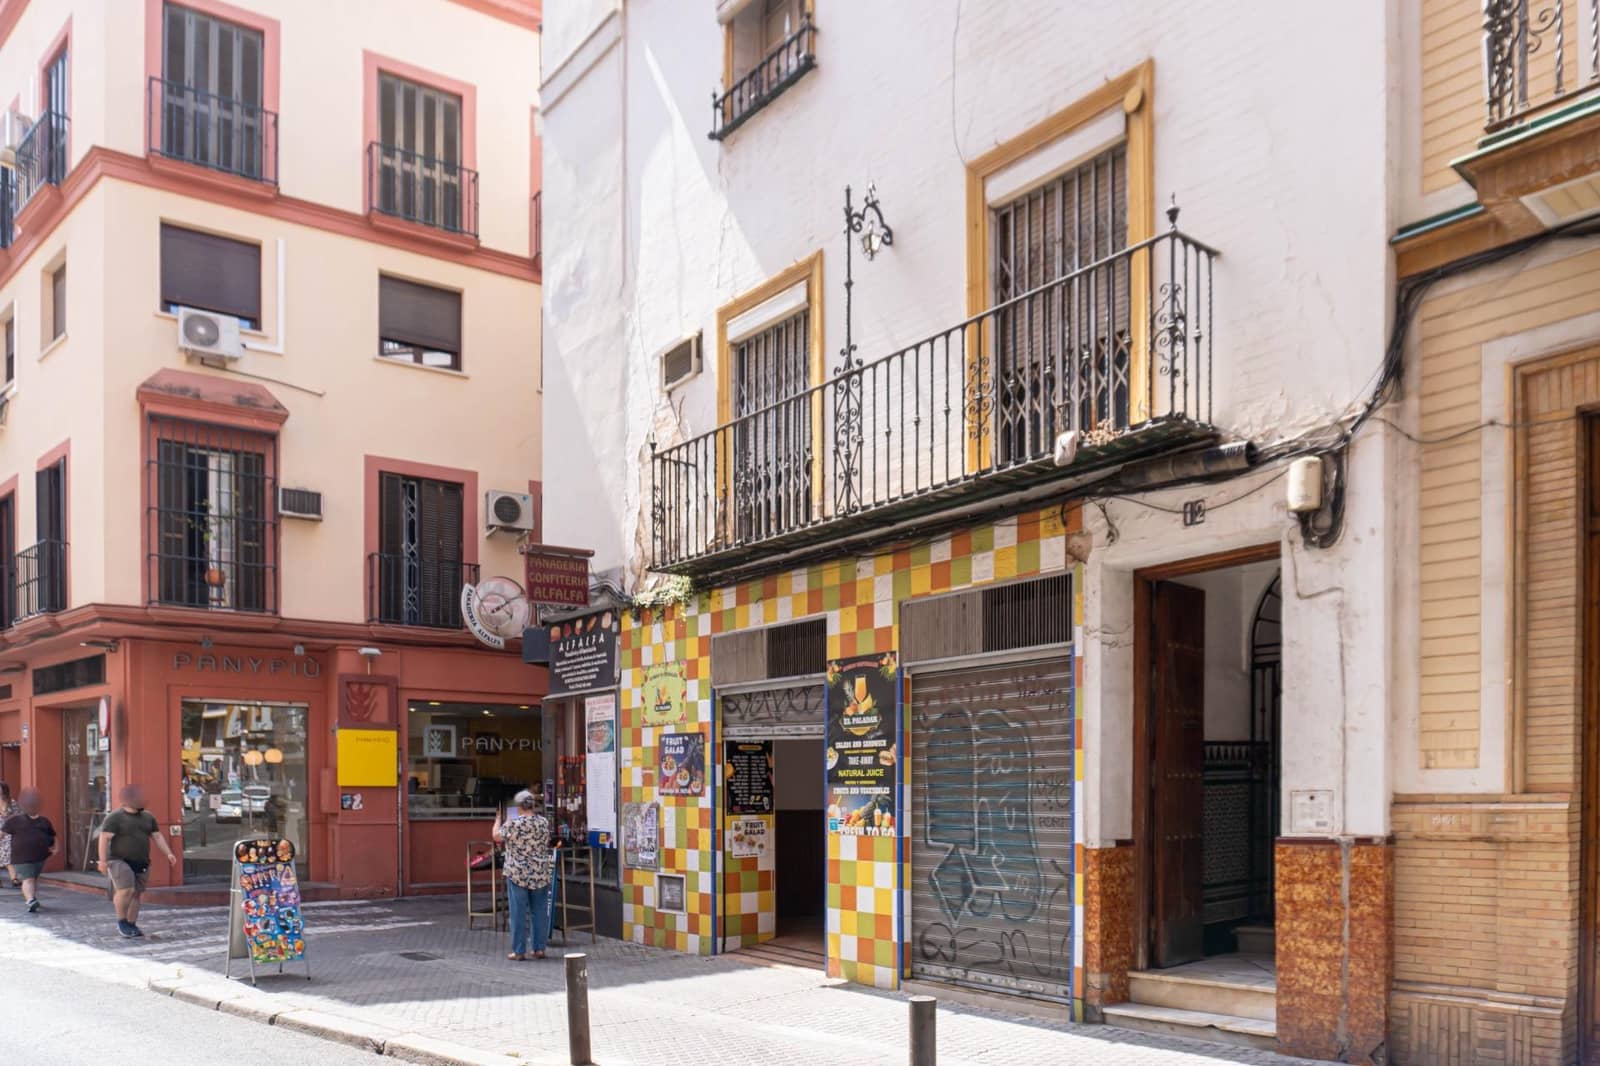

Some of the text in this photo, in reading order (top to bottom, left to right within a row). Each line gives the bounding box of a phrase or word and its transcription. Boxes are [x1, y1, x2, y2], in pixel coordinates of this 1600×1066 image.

[1186, 502, 1205, 525] 12
[534, 587, 585, 602] ALFALFA
[558, 631, 605, 652] ALFALFA
[664, 746, 685, 754] SALAD
[838, 768, 885, 777] NATURAL JUICE
